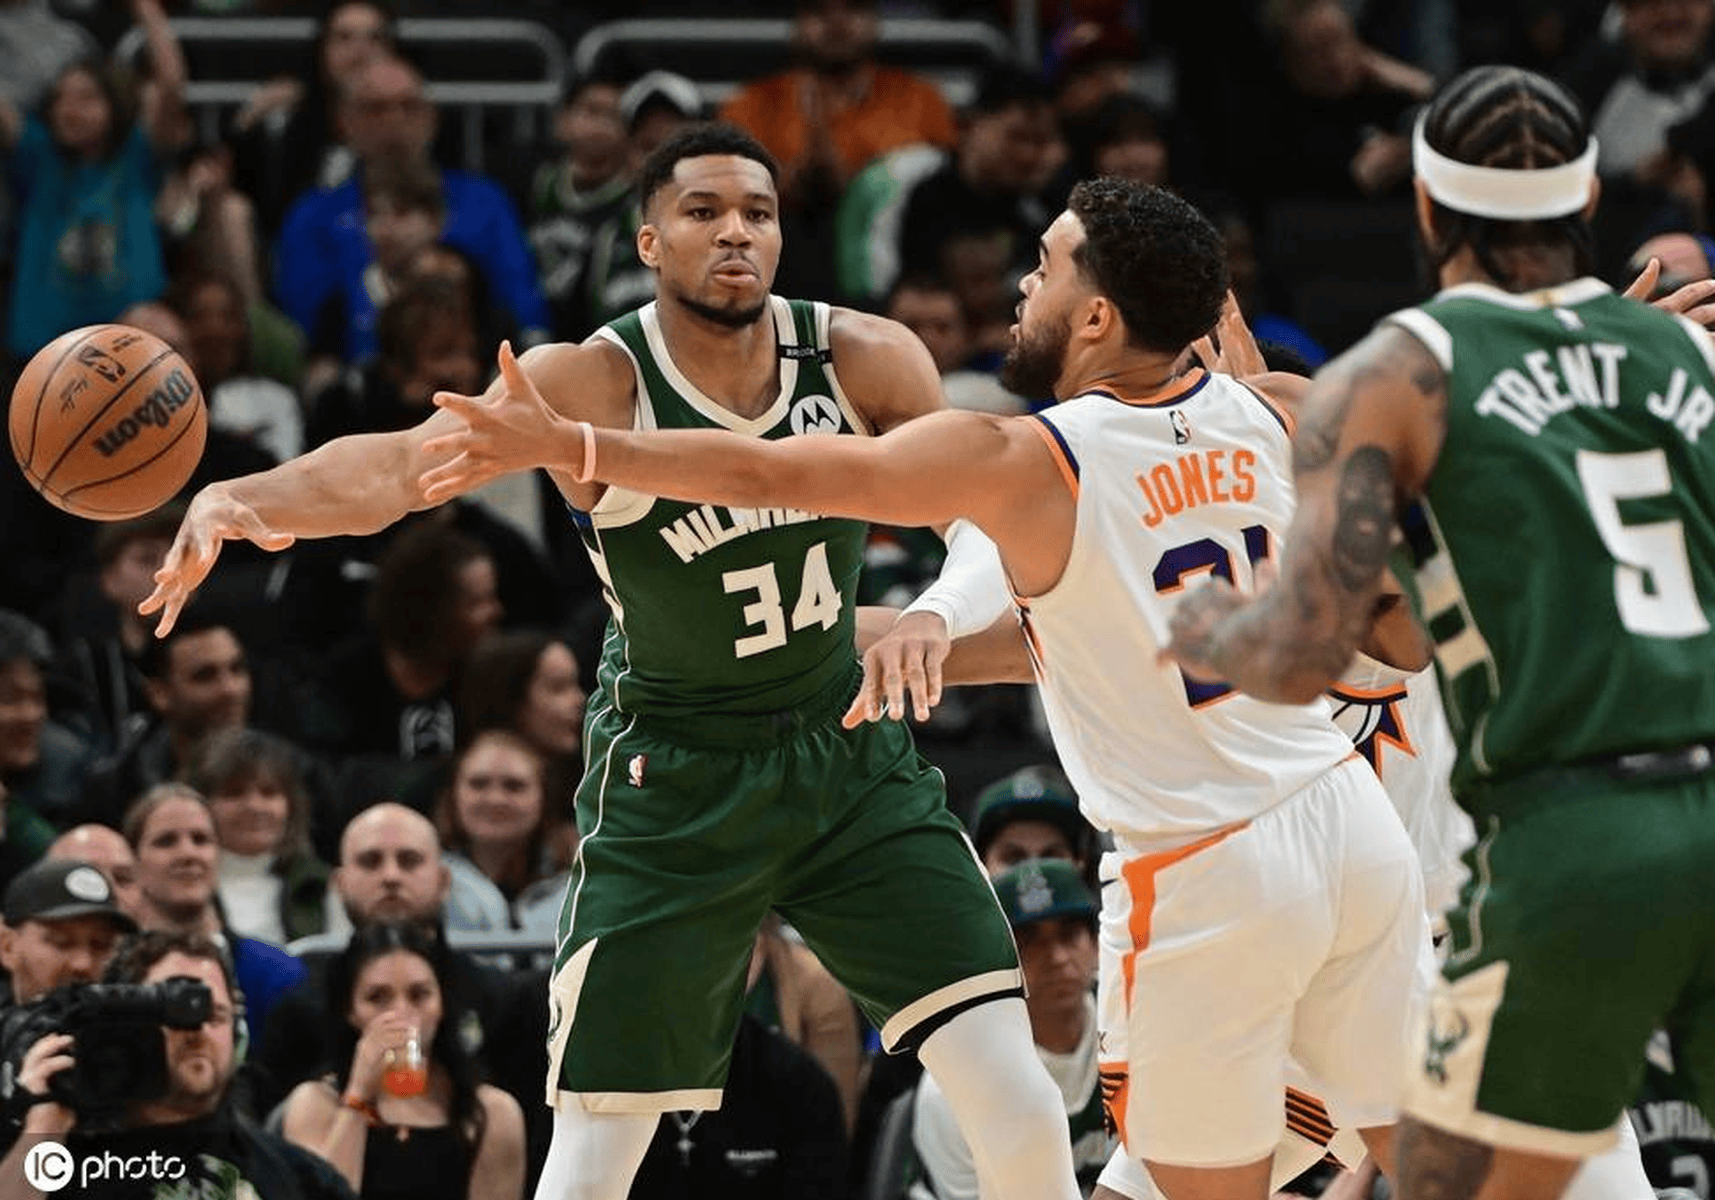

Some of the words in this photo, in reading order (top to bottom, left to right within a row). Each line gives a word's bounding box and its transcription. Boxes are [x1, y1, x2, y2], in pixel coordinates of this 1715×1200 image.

[92, 368, 193, 458] Wilson
[1474, 342, 1628, 436] TRENT
[1645, 367, 1715, 443] JR
[1136, 449, 1258, 529] JONES
[1575, 448, 1710, 638] 5
[722, 541, 843, 658] 34
